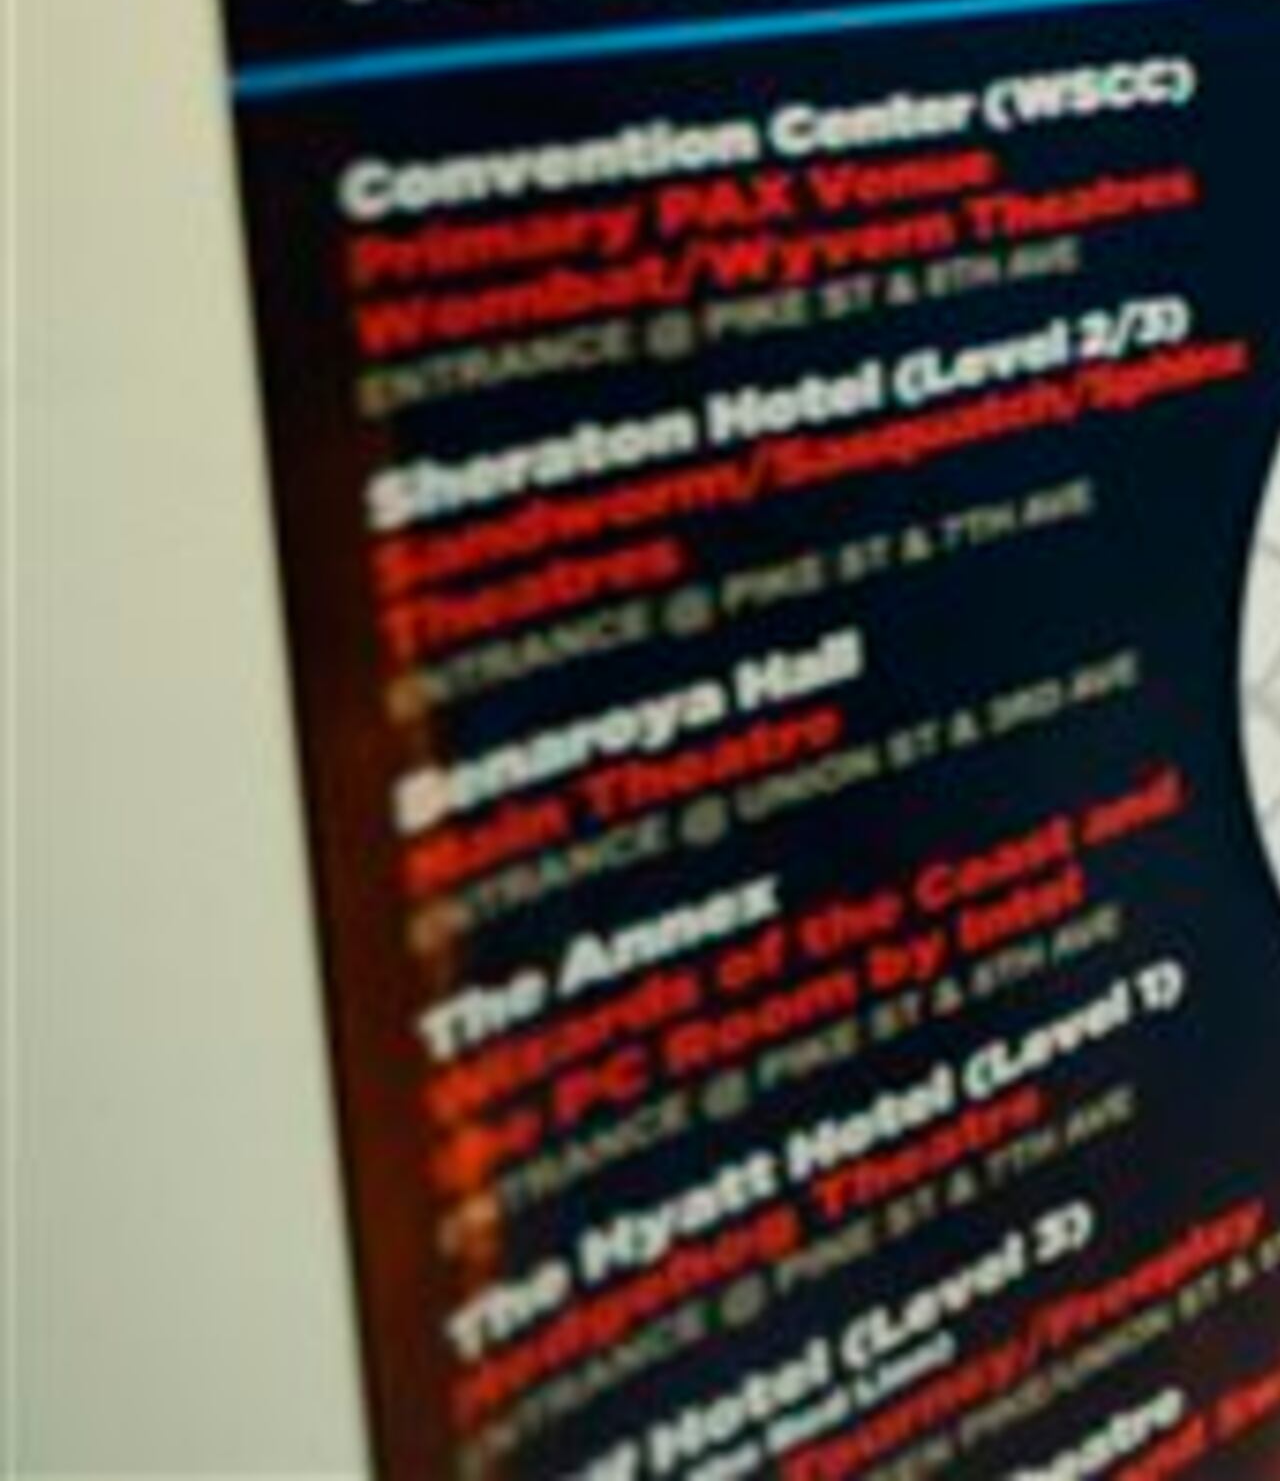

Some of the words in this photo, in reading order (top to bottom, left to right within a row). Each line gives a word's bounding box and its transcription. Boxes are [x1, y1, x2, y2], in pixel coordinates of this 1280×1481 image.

[339, 118, 758, 220] Convention
[771, 86, 975, 157] Center
[983, 57, 1196, 127] (WSCC)
[354, 196, 641, 280] Primary
[658, 168, 796, 233] PAX
[814, 150, 994, 212] Venue
[819, 278, 874, 319] ST
[1007, 236, 1083, 279] AVE
[366, 401, 697, 531] Sheraton
[705, 361, 886, 446] Hotel
[891, 324, 1070, 400] (Level
[839, 538, 892, 583] ST
[1020, 477, 1095, 521] AVE
[395, 676, 729, 832] Benaroya
[733, 626, 863, 711] Hall
[583, 706, 844, 817] Theatre
[1068, 648, 1141, 702] AVE
[719, 932, 785, 993] of
[801, 888, 904, 953] the
[914, 815, 1076, 912] Coast
[1078, 760, 1186, 844] and
[420, 964, 551, 1056] The
[559, 873, 781, 994] Annex
[552, 1050, 648, 1130] PC
[662, 967, 858, 1069] Room
[870, 926, 948, 993] by
[447, 1259, 572, 1360] The
[578, 1154, 777, 1284] Hyatt
[787, 1062, 956, 1180] Hotel
[962, 982, 1127, 1098] (Level
[812, 1084, 1046, 1221] Theatre
[648, 1336, 828, 1475] Hotel
[842, 1230, 1027, 1368] (Level
